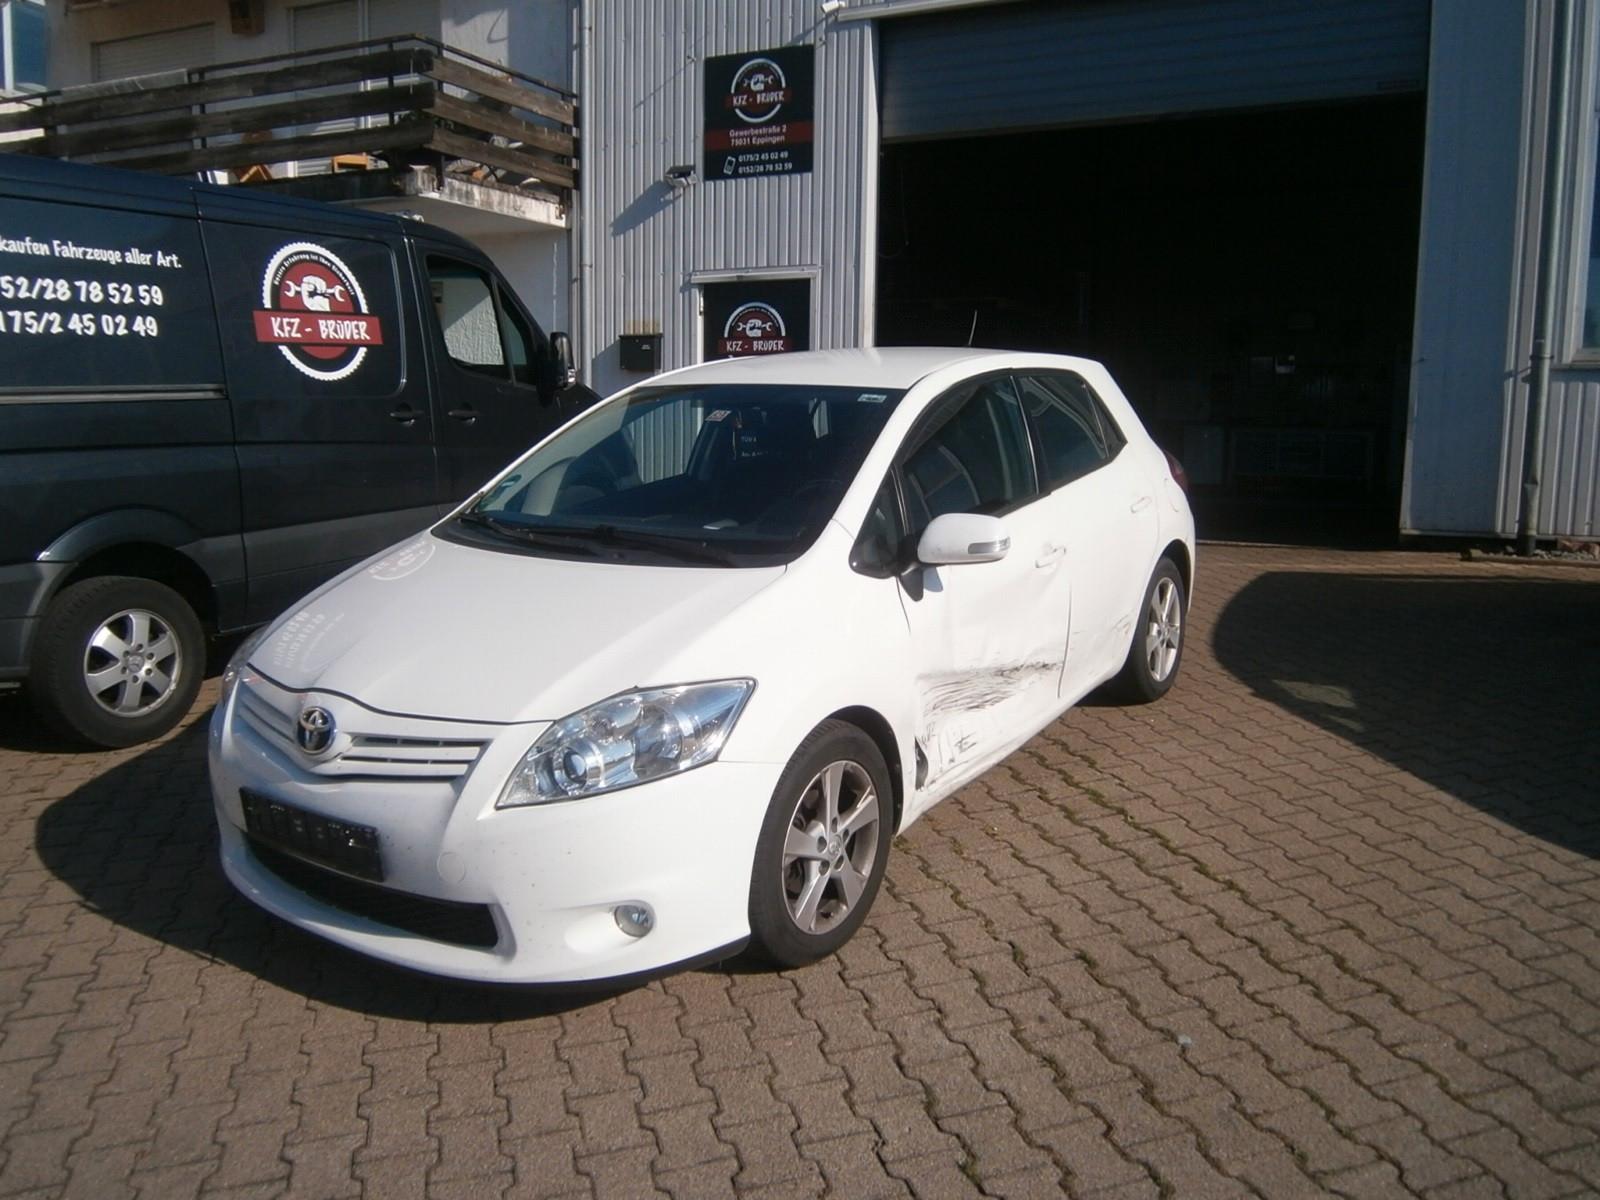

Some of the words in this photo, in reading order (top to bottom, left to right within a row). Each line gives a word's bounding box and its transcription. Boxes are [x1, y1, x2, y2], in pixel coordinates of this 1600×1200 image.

[52, 239, 123, 266] Fahrzeuge
[125, 247, 153, 266] aller
[157, 250, 182, 269] Art.
[74, 280, 104, 303] 78
[107, 282, 135, 304] 52
[138, 284, 164, 306] 59
[67, 313, 96, 335] 45
[101, 314, 129, 336] 02
[132, 315, 158, 337] 49
[270, 316, 302, 338] KFZ
[318, 319, 371, 340] BRÜDER
[726, 341, 742, 352] KFZ
